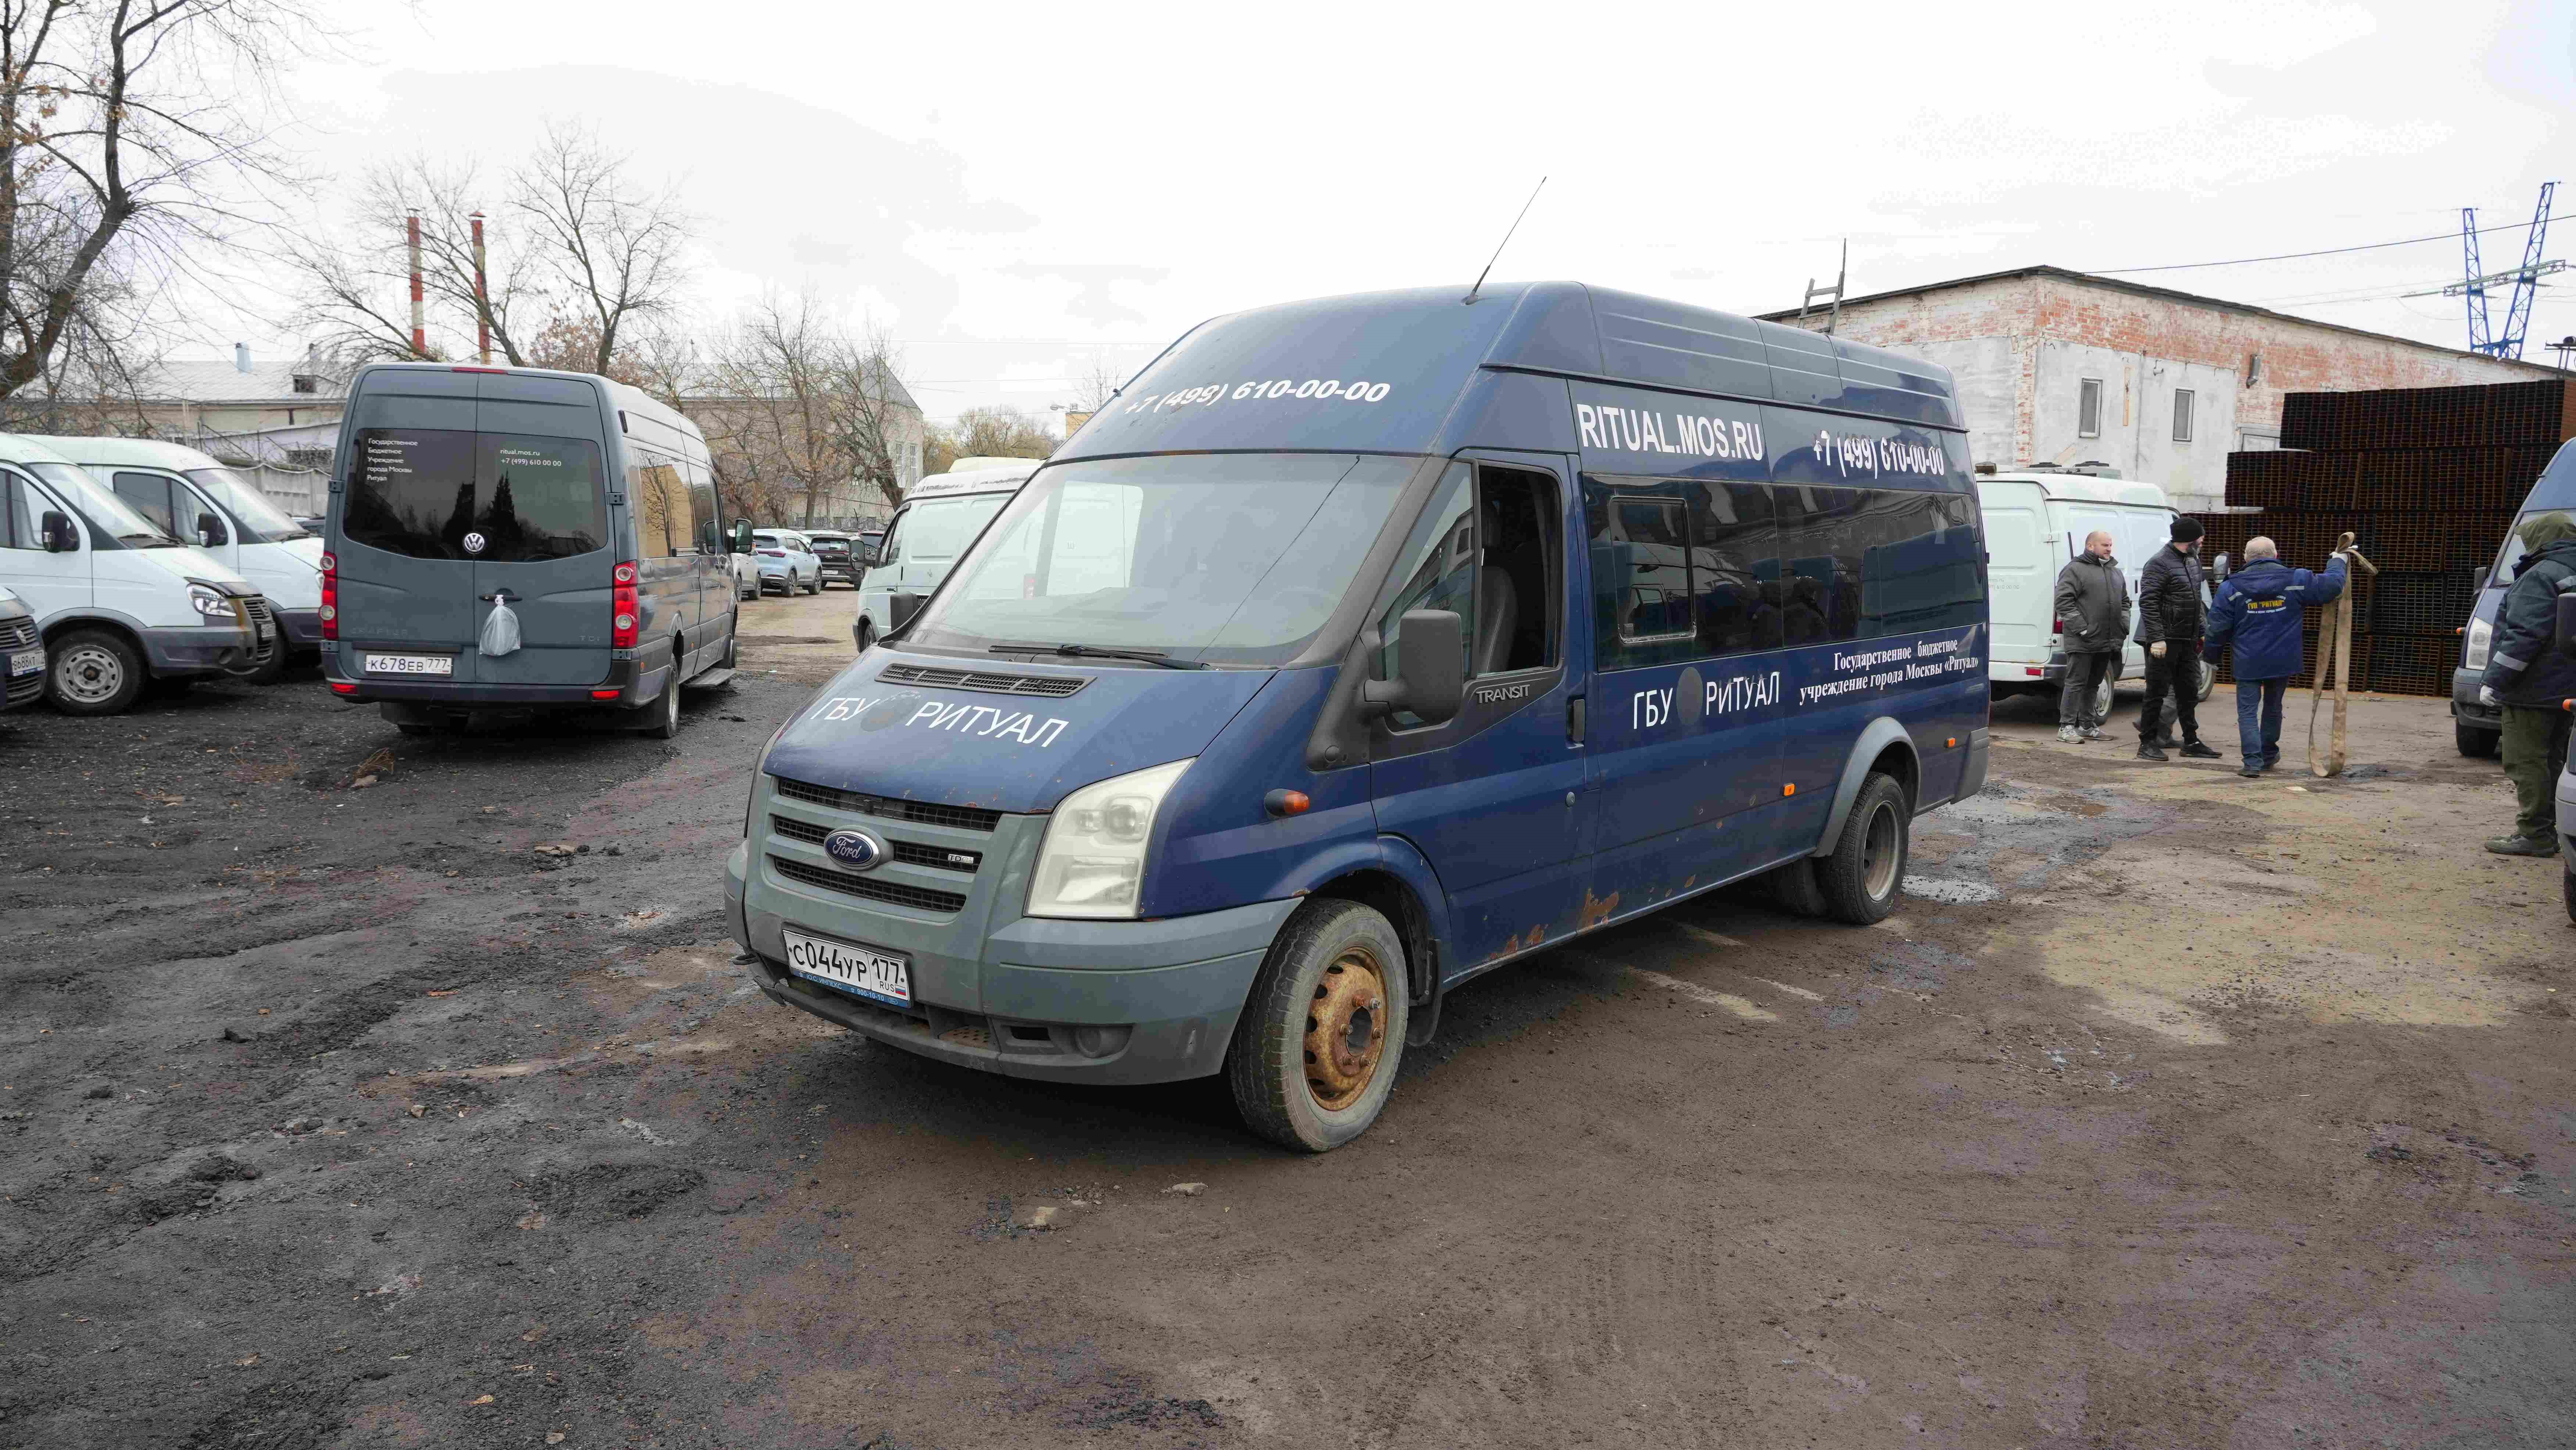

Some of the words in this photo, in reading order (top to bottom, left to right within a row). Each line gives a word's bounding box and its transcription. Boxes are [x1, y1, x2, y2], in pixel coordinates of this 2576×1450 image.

[1153, 383, 1228, 413] (499)
[1232, 379, 1391, 402] 610-00-00
[1577, 404, 1763, 461] RITUAL.MOS.RU
[1838, 437, 1878, 479] (499)
[1881, 436, 1944, 475] 610-00-00
[371, 658, 423, 671] К678ЕВ
[427, 658, 447, 668] 777
[1834, 646, 1911, 673] Государственное
[1917, 639, 1958, 657] бюджетное
[1476, 685, 1530, 703] TRANSIT
[1799, 676, 1868, 706] учреждение
[1870, 669, 1903, 690] города
[1905, 662, 1942, 681] Москвы
[1944, 656, 1979, 673] «Ритуал»
[1634, 688, 1673, 729] ГБУ
[1706, 671, 1780, 715] РИТУАЛ
[810, 697, 881, 721] ГБУ
[905, 701, 1069, 747] РИТУАЛ
[833, 836, 862, 859] Ford
[793, 941, 867, 982] С044УР
[872, 958, 899, 984] 177
[857, 989, 884, 1001] 900-10-10
[880, 981, 894, 992] RUS
